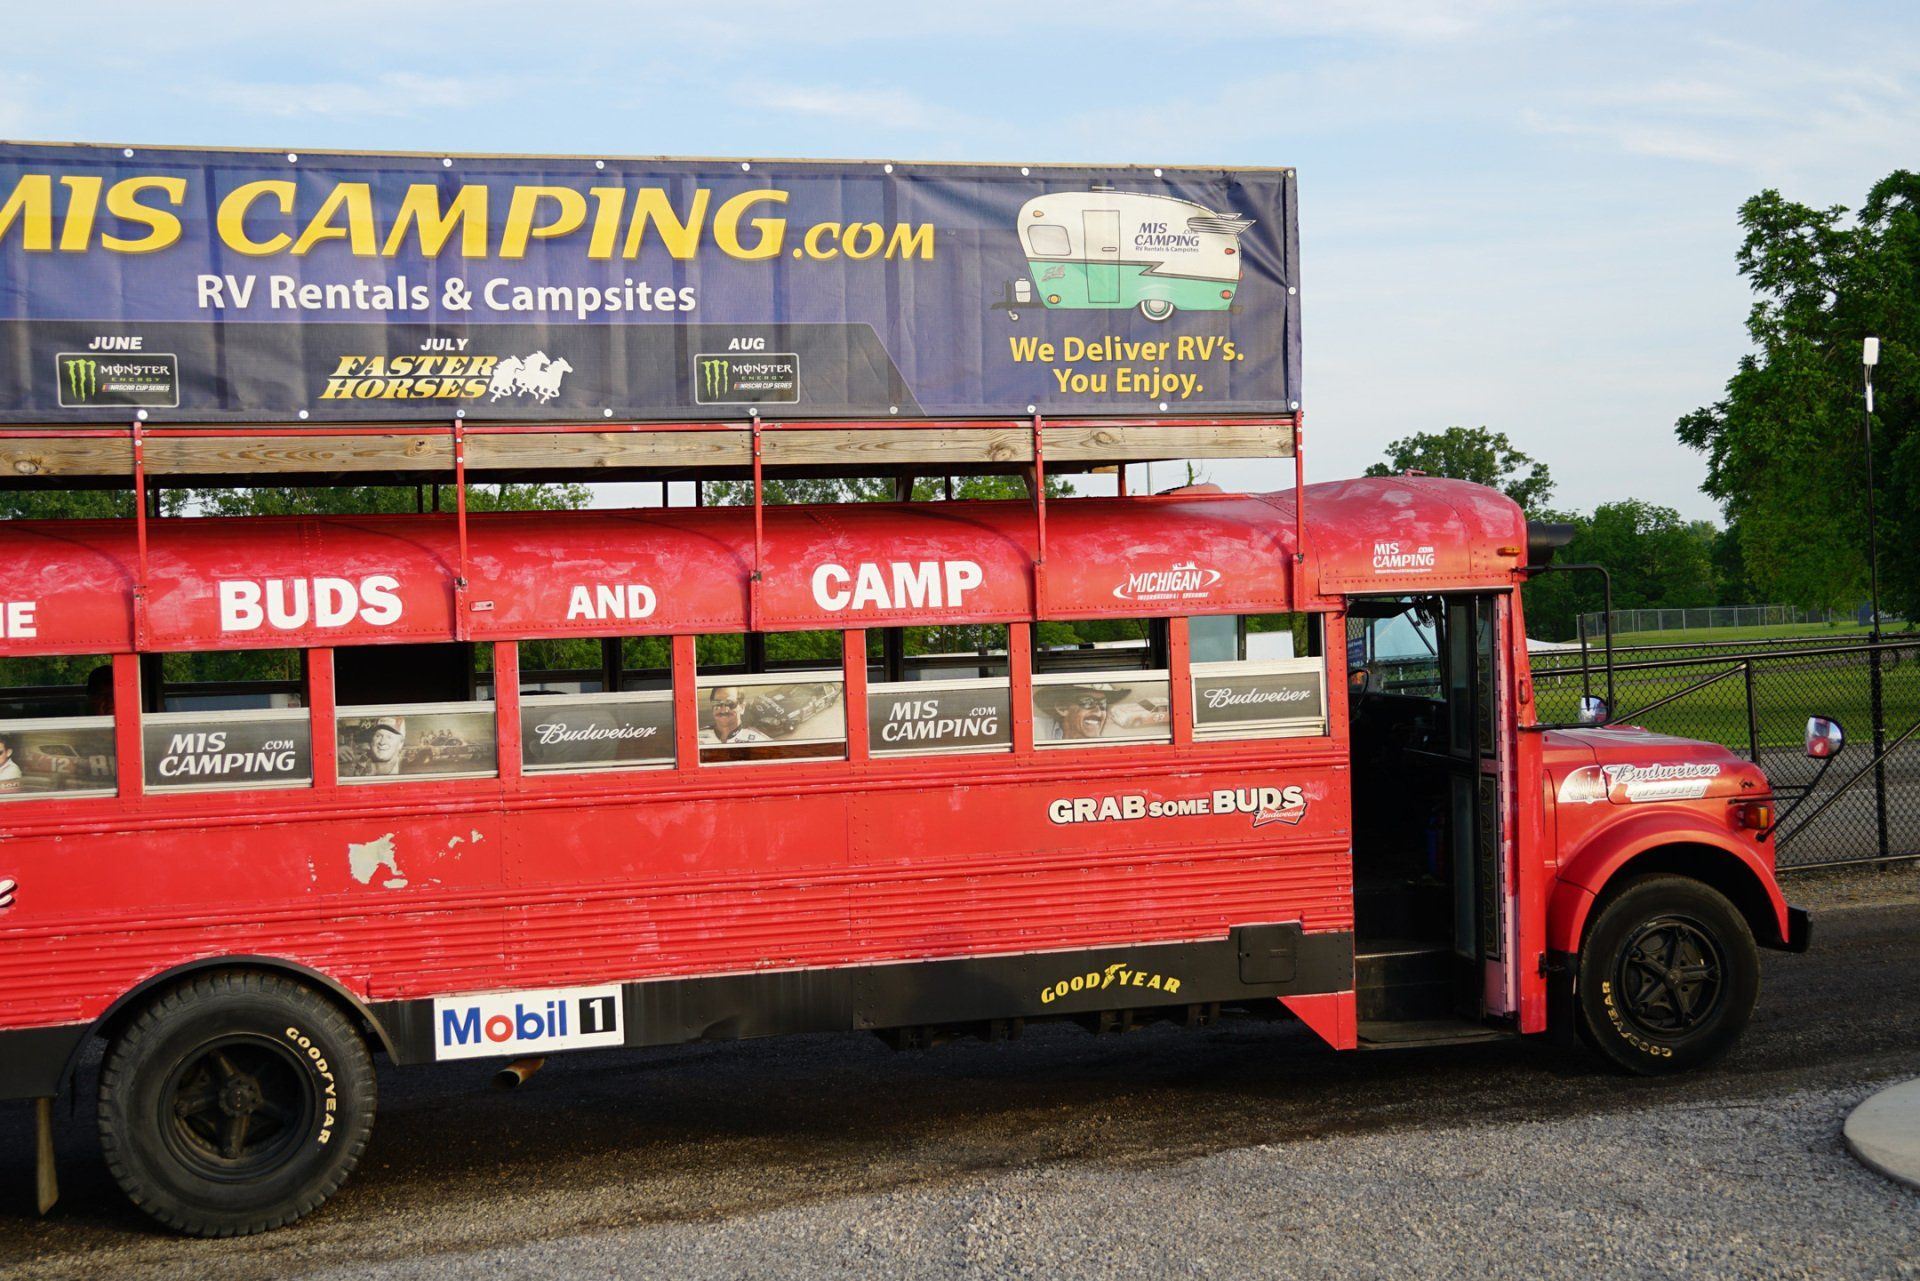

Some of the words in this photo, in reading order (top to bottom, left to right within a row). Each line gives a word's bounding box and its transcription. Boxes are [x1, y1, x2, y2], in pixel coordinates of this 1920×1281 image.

[1139, 222, 1167, 234] MIS
[1134, 234, 1200, 246] CAMPING
[197, 274, 256, 308] RV
[271, 276, 430, 310] Rentals
[442, 277, 473, 310] &
[484, 277, 696, 319] Campsites
[89, 336, 143, 350] JUNE
[420, 338, 469, 351] JULY
[728, 338, 765, 350] AUG
[1010, 337, 1055, 362] We
[1064, 336, 1171, 362] Deliver
[1177, 336, 1245, 362] RV's.
[101, 364, 170, 375] MONSTER
[330, 355, 499, 377] FASTER
[732, 363, 793, 375] MONSTER
[318, 378, 491, 399] HORSES
[1054, 368, 1107, 394] You
[1116, 367, 1204, 399] Enjoy.
[1374, 543, 1399, 555] MIS
[1373, 554, 1435, 568] CAMPING
[812, 560, 983, 611] CAMP
[1127, 571, 1203, 593] MICHIGAN
[219, 575, 402, 631] BUDS
[567, 585, 657, 619] AND
[1204, 687, 1310, 708] Budweiser
[889, 700, 939, 721] MIS
[969, 706, 996, 716] .COM
[535, 723, 657, 744] Budweiser
[882, 717, 998, 741] CAMPING
[168, 732, 227, 754] MIS
[262, 740, 294, 750] .COM
[159, 751, 296, 776] CAMPING
[1603, 763, 1720, 782] Budweiser
[1049, 795, 1147, 824] GRAB
[1149, 799, 1210, 817] SOME
[1213, 786, 1304, 814] BUDS
[1041, 963, 1181, 1003] GOODYEAR
[443, 1000, 568, 1046] Mobil
[590, 999, 604, 1031] 1
[286, 1027, 337, 1144] GOODYEAR
